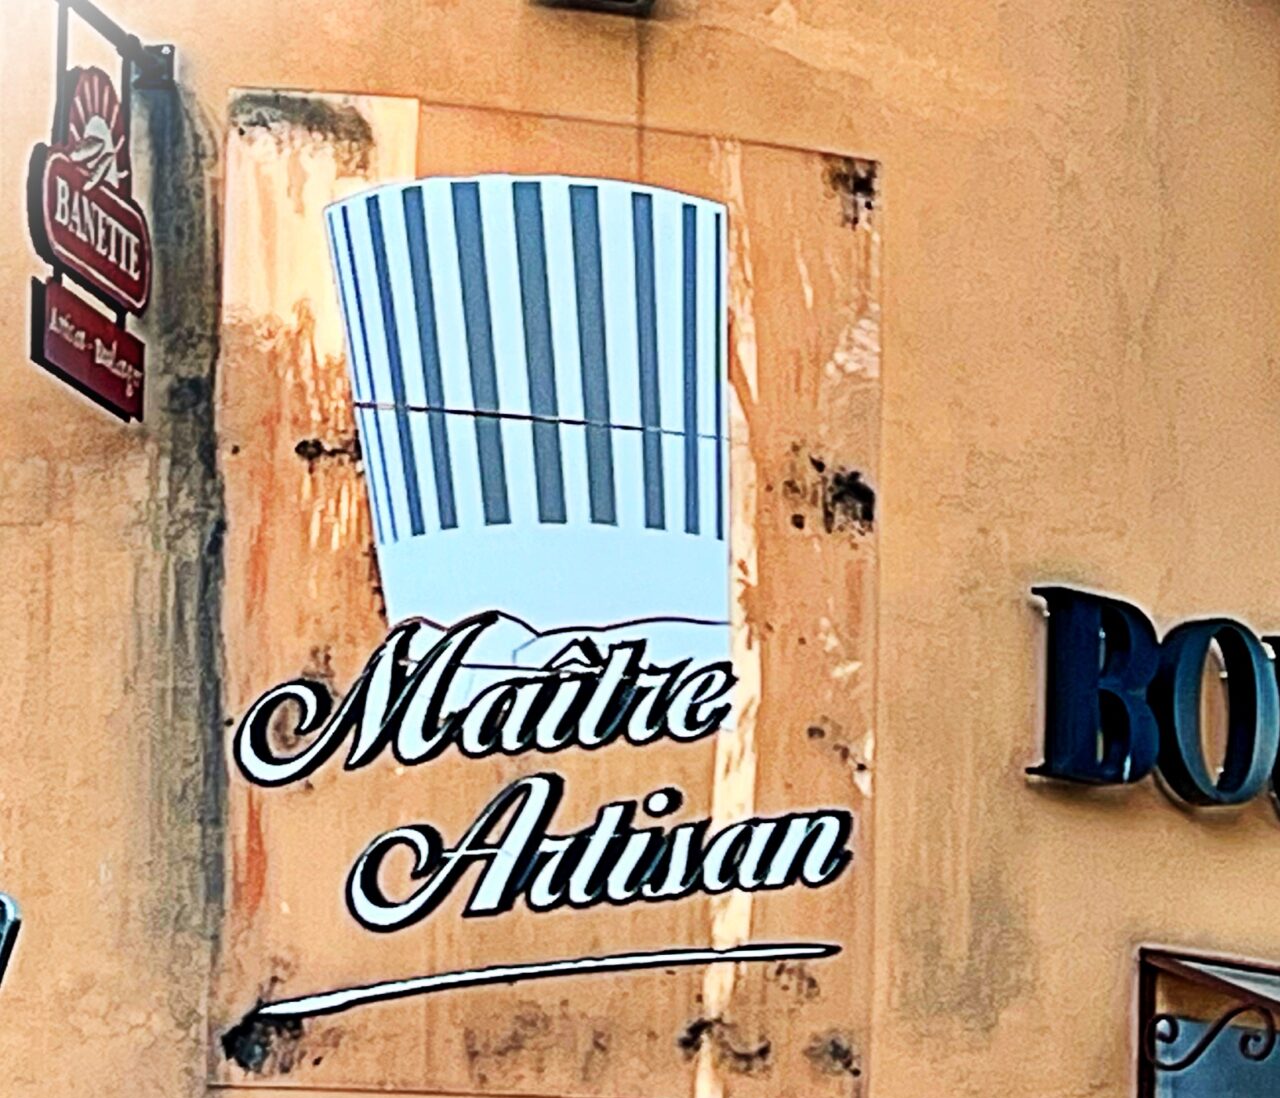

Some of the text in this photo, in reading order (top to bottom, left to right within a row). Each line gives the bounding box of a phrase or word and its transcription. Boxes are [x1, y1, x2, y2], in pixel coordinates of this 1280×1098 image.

[55, 175, 141, 282] BANETTE
[233, 609, 740, 788] Maître
[345, 771, 854, 933] Artisan
